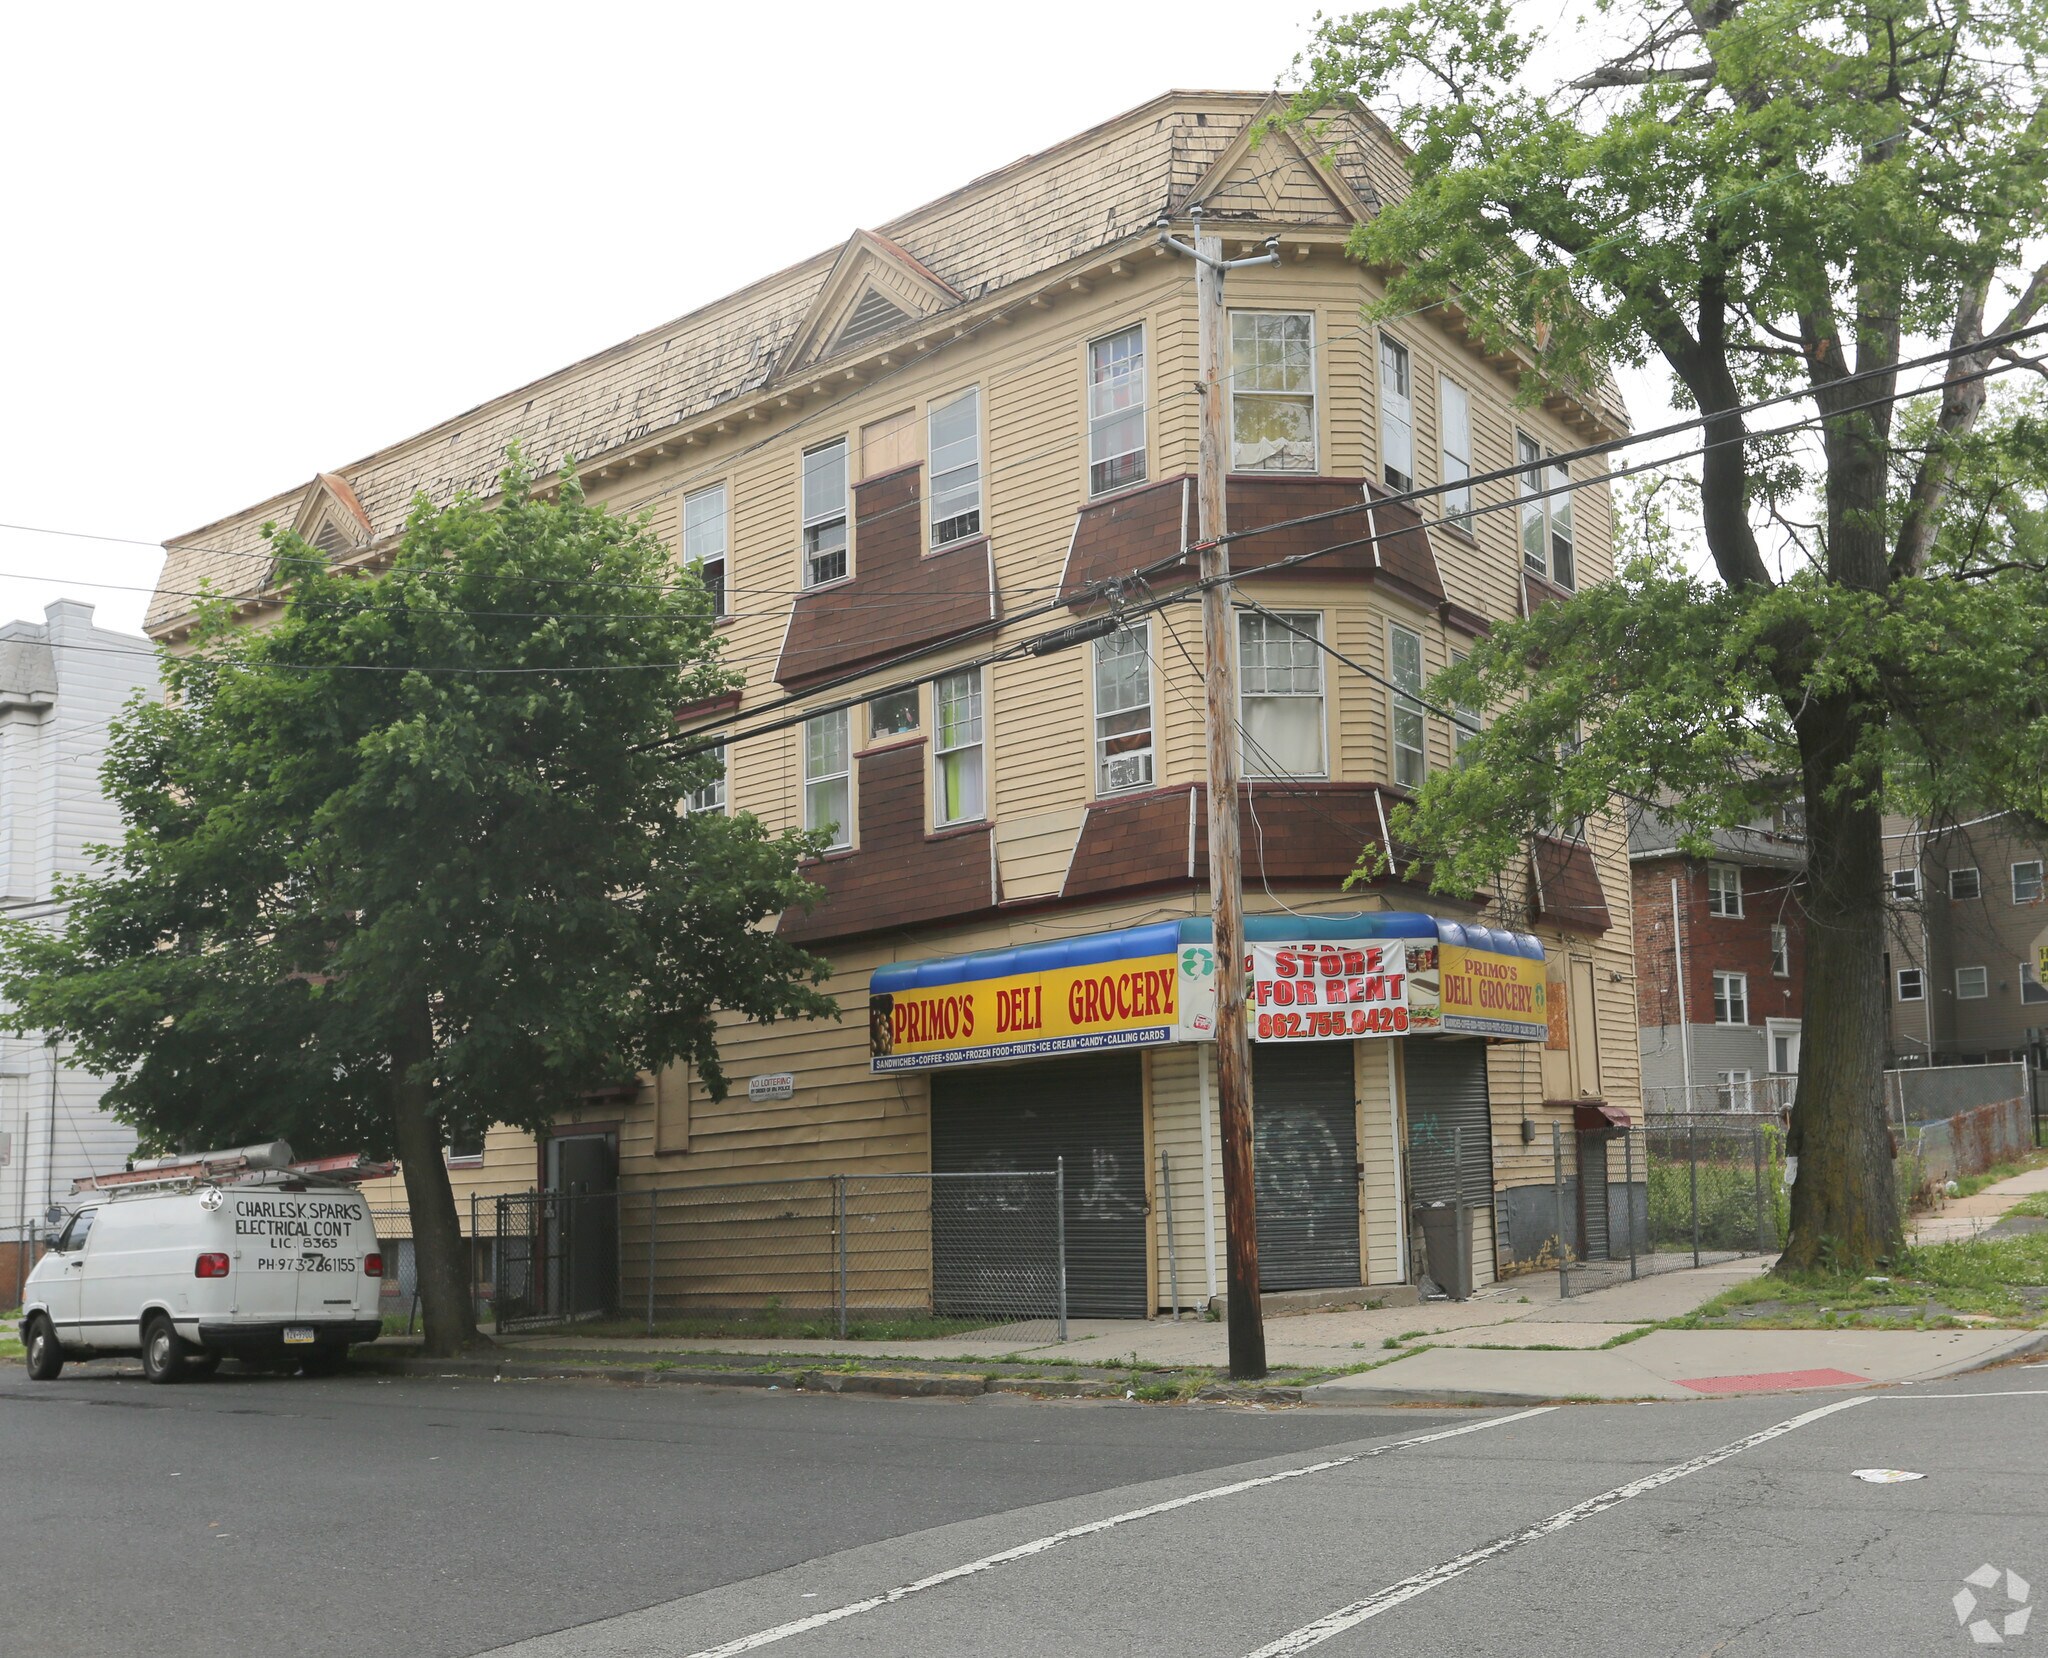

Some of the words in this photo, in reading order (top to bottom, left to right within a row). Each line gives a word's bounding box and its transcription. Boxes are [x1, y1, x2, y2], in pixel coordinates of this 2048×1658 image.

[1275, 947, 1385, 978] STORE
[1464, 959, 1518, 981] PRIMO'S
[894, 994, 975, 1044] PRIMO'S
[996, 985, 1042, 1033] DELI
[1068, 968, 1175, 1025] GROCERY
[1256, 979, 1317, 1007] FOR
[1325, 974, 1405, 1004] RENT
[1444, 974, 1473, 1006] DELI
[1479, 978, 1532, 1013] GROCERY
[1257, 1006, 1409, 1039] 862.755.8426
[876, 1056, 916, 1069] SANDWICHES
[918, 1053, 942, 1065] COFFEE
[945, 1051, 963, 1062] SODA
[965, 1048, 991, 1060] FROZEN
[992, 1045, 1010, 1057] FOOD
[1012, 1043, 1037, 1054] FRUITS
[1039, 1042, 1051, 1052] ICE
[1052, 1039, 1077, 1050] CREAM
[1080, 1036, 1104, 1047] CANDY
[1107, 1032, 1138, 1044] CALLING
[1139, 1029, 1165, 1041] CARDS
[750, 1080, 759, 1088] NO
[760, 1077, 791, 1087] LOITERING
[236, 1201, 296, 1219] CHARLES
[309, 1203, 363, 1221] SPARKS
[236, 1220, 311, 1237] ELECTRICAL
[302, 1238, 338, 1249] 8365
